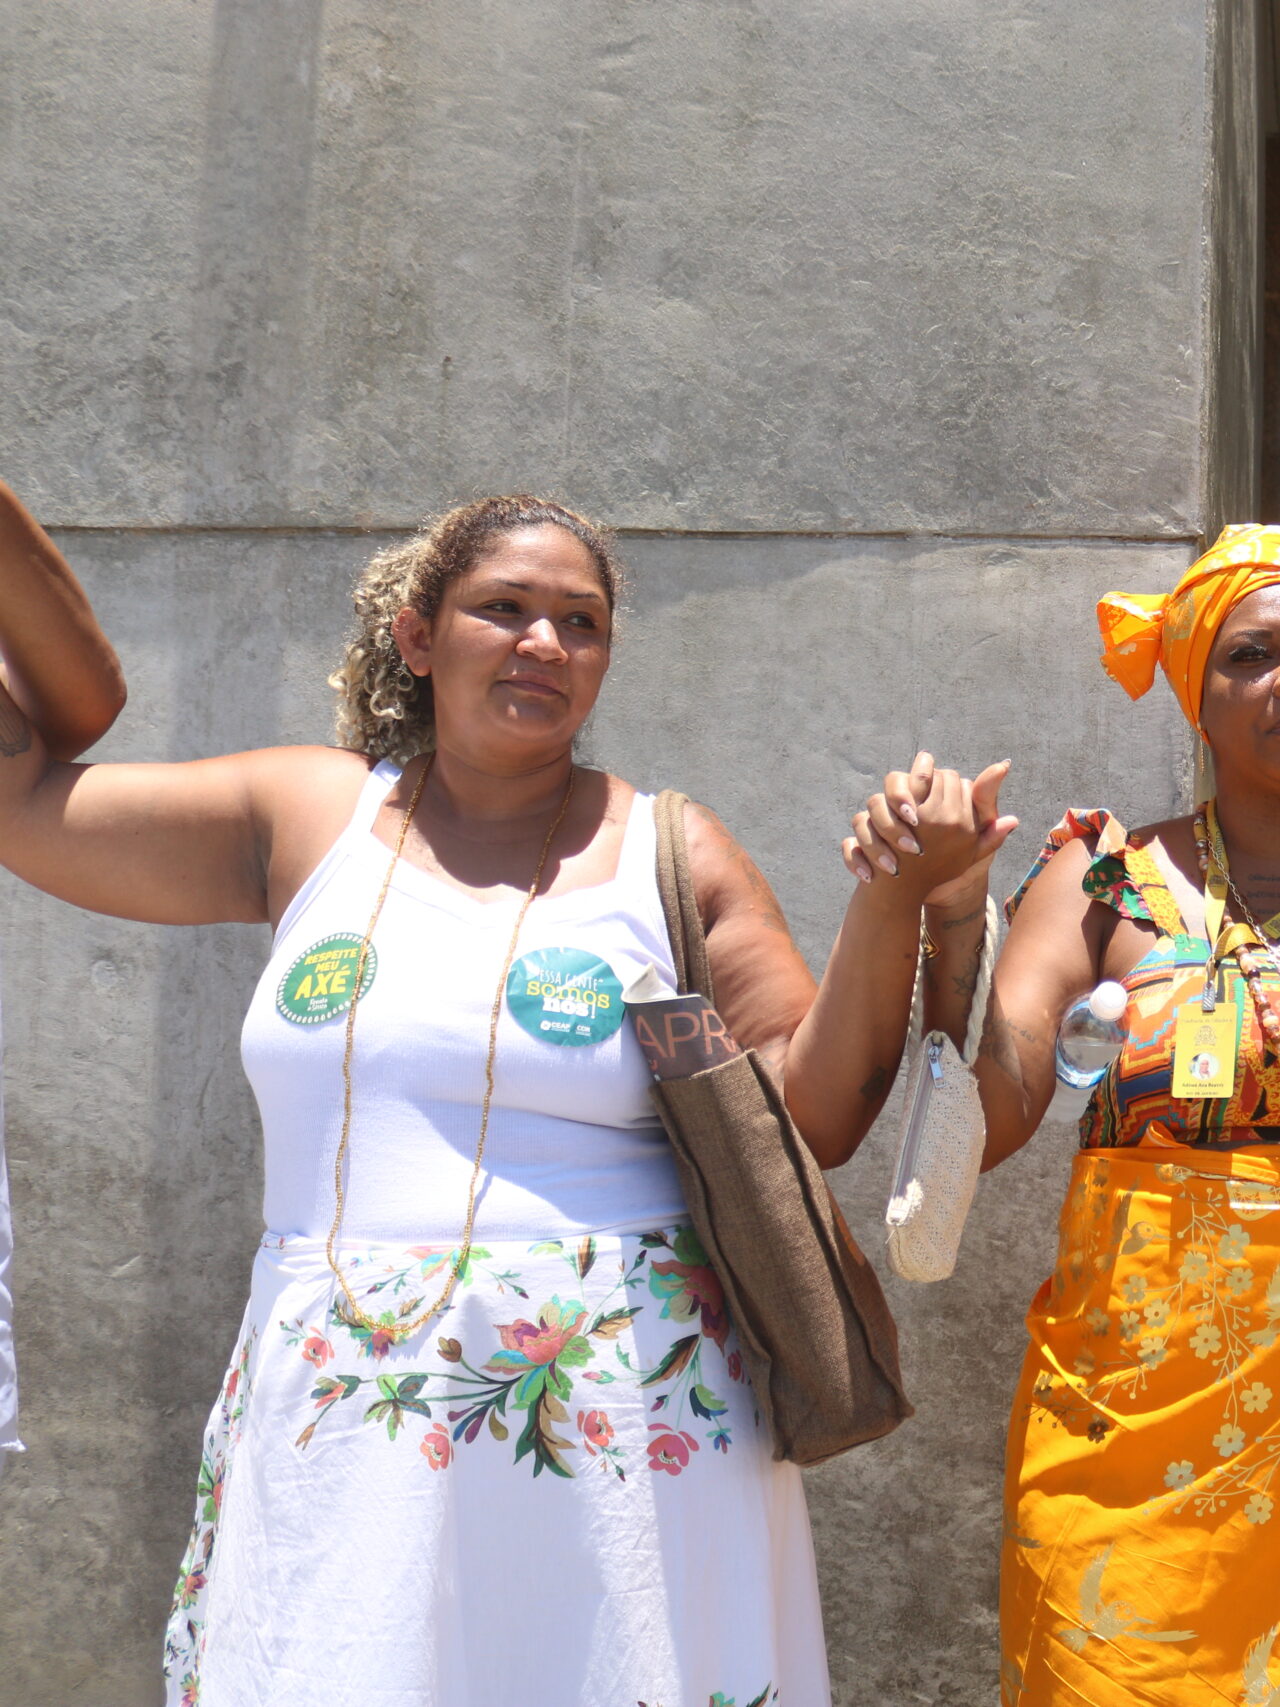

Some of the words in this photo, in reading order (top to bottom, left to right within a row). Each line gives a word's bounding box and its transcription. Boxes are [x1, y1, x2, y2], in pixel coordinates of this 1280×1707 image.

[304, 948, 359, 965] RESPEITE
[314, 960, 340, 973] MEU
[294, 964, 351, 1000] AXÉ
[526, 980, 610, 1009] somos
[636, 1009, 738, 1059] APR
